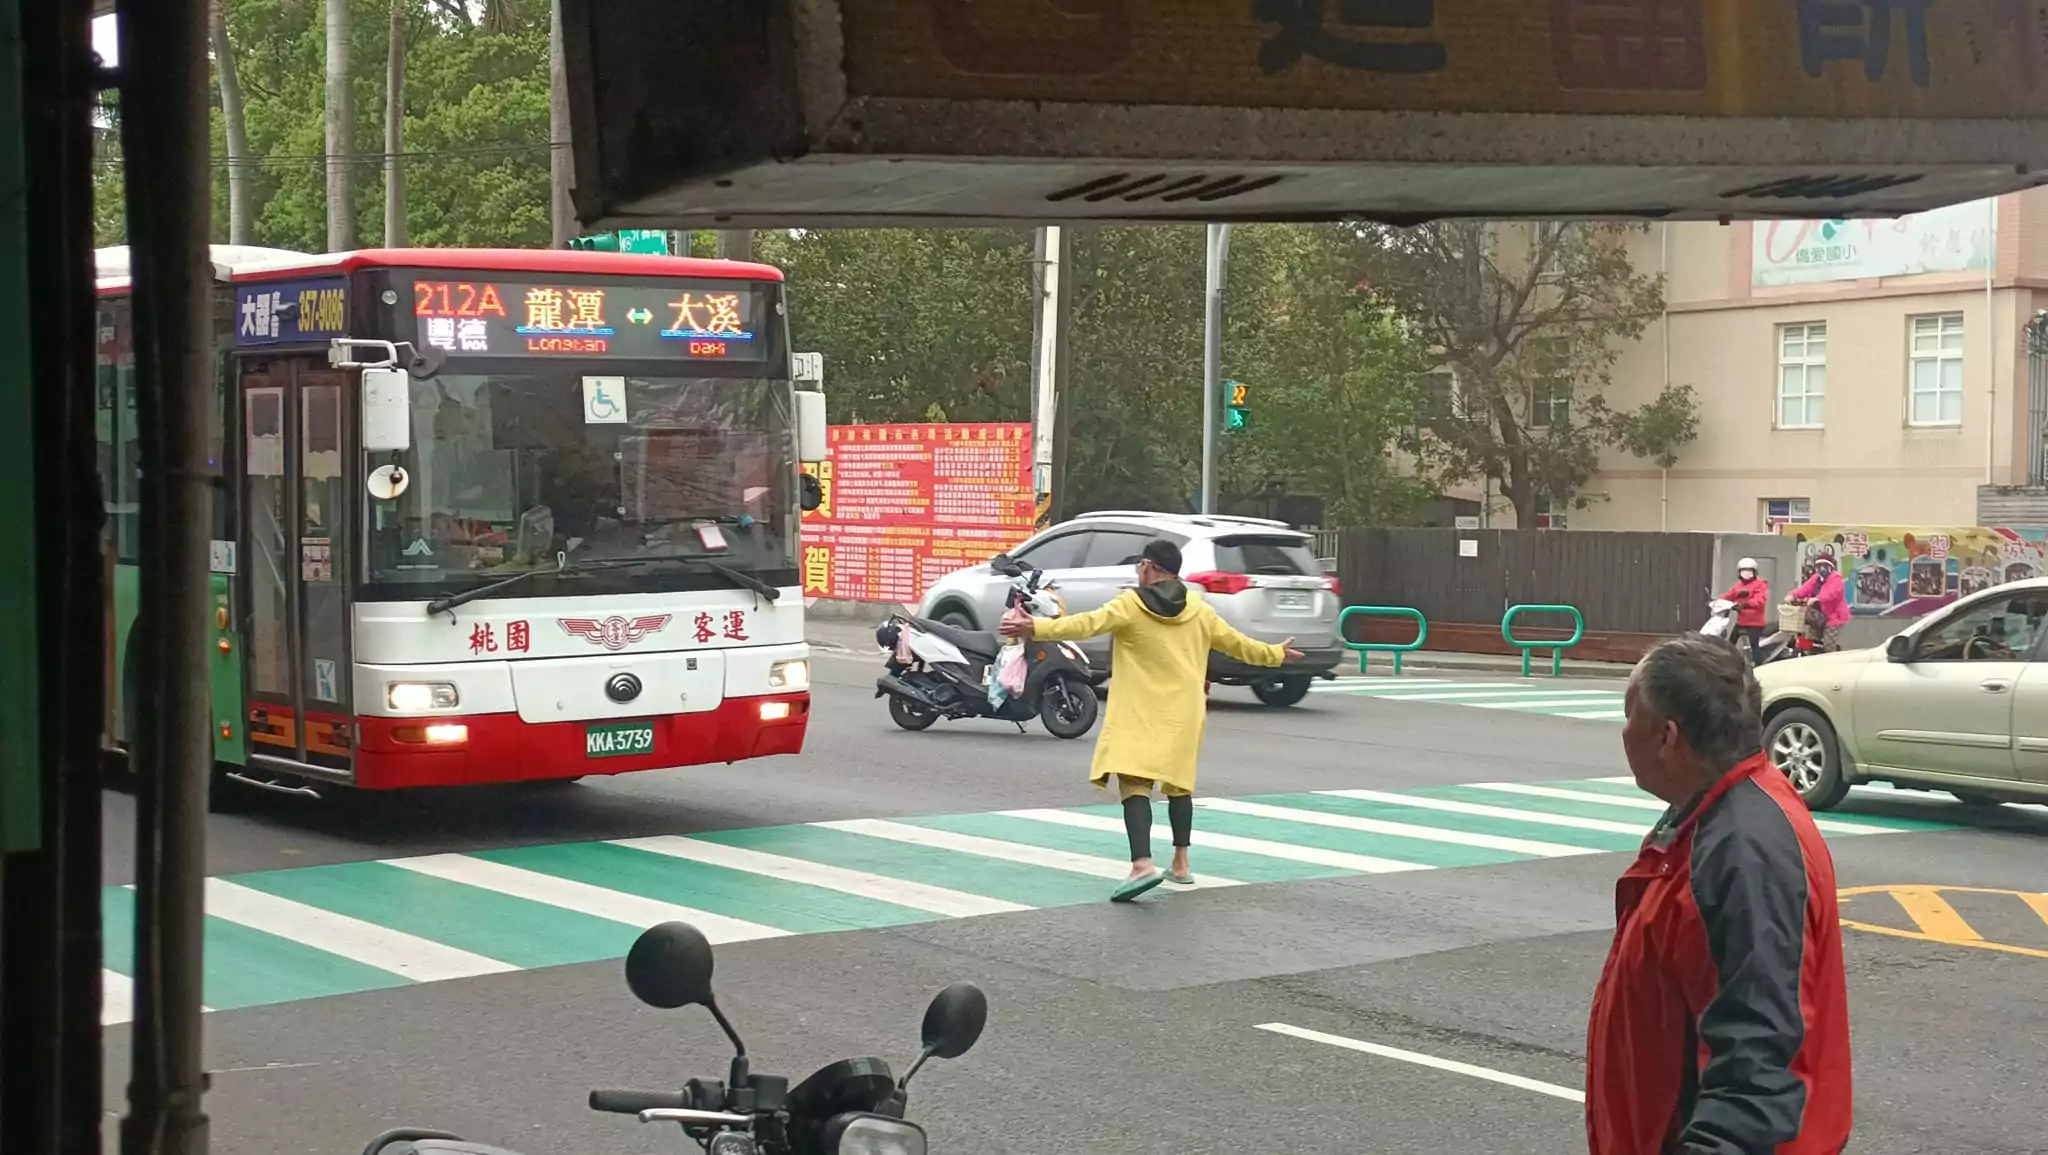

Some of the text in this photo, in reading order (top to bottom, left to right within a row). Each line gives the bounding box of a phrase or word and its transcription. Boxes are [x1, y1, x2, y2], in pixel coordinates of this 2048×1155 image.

[1796, 245, 1857, 263] 僑愛國小
[299, 288, 344, 332] 357-9086
[414, 282, 507, 316] 212A
[524, 288, 742, 334] 龍潭 大溪
[804, 545, 830, 593] 賀
[469, 611, 750, 655] 桃園 客運
[587, 730, 653, 753] KKA-3739
